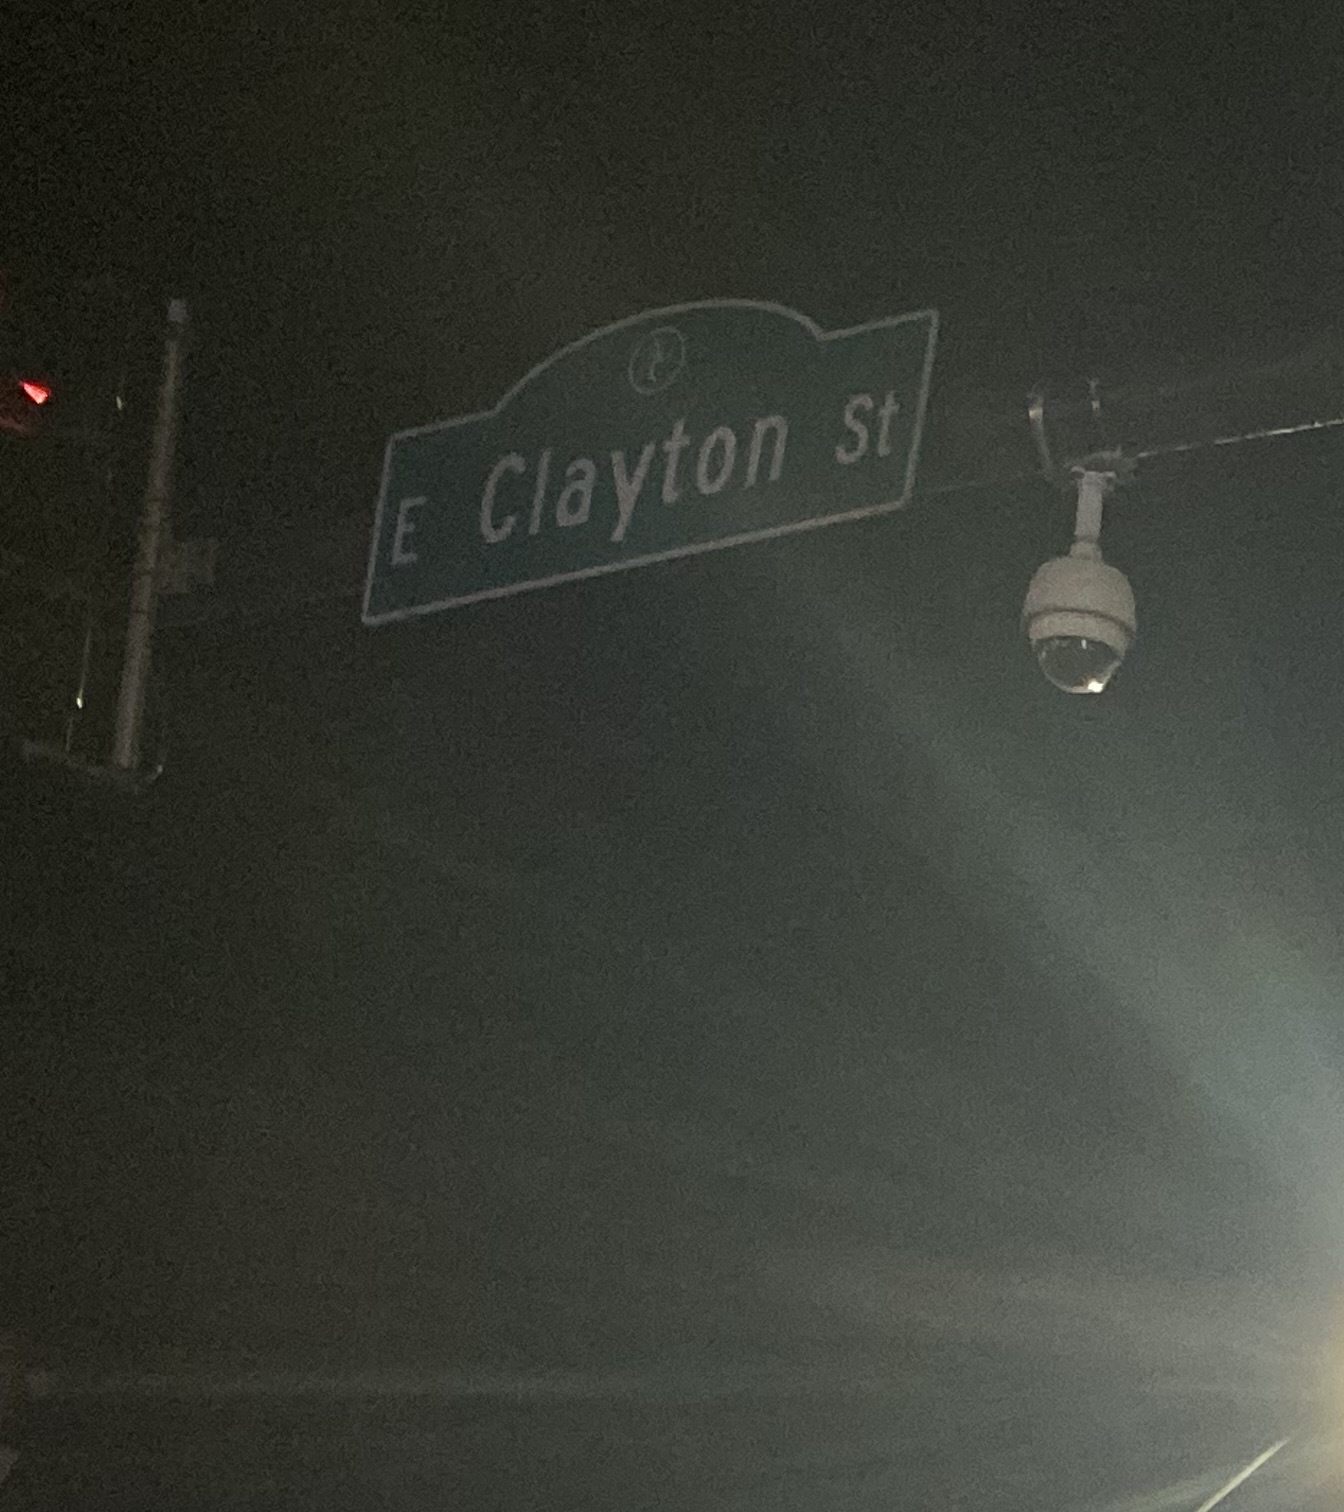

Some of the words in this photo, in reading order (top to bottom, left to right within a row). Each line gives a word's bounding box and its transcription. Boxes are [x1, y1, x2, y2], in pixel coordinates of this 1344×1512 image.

[390, 495, 427, 567] E
[480, 415, 789, 545] Clayton
[835, 390, 901, 465] St
